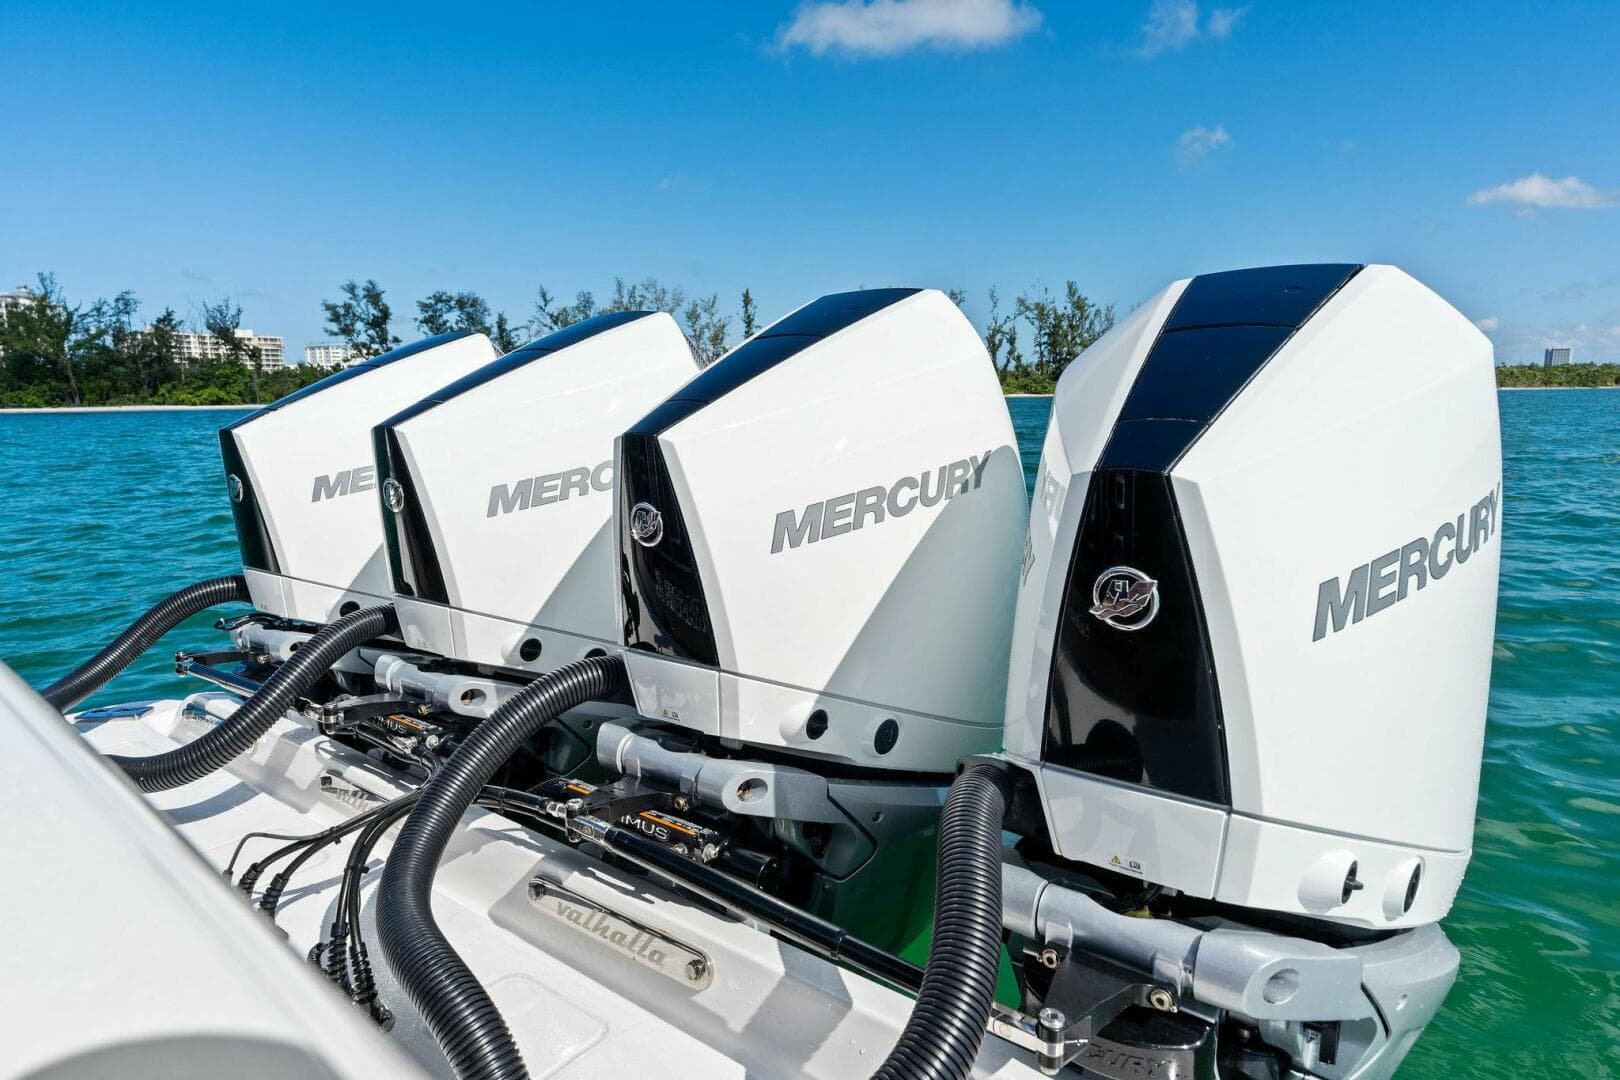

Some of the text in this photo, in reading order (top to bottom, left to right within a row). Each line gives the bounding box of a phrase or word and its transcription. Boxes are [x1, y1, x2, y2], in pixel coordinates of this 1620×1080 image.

[312, 465, 376, 502] ME
[770, 450, 992, 554] MERCURY
[1313, 481, 1500, 642] MERCURY
[557, 901, 667, 966] valhalla
